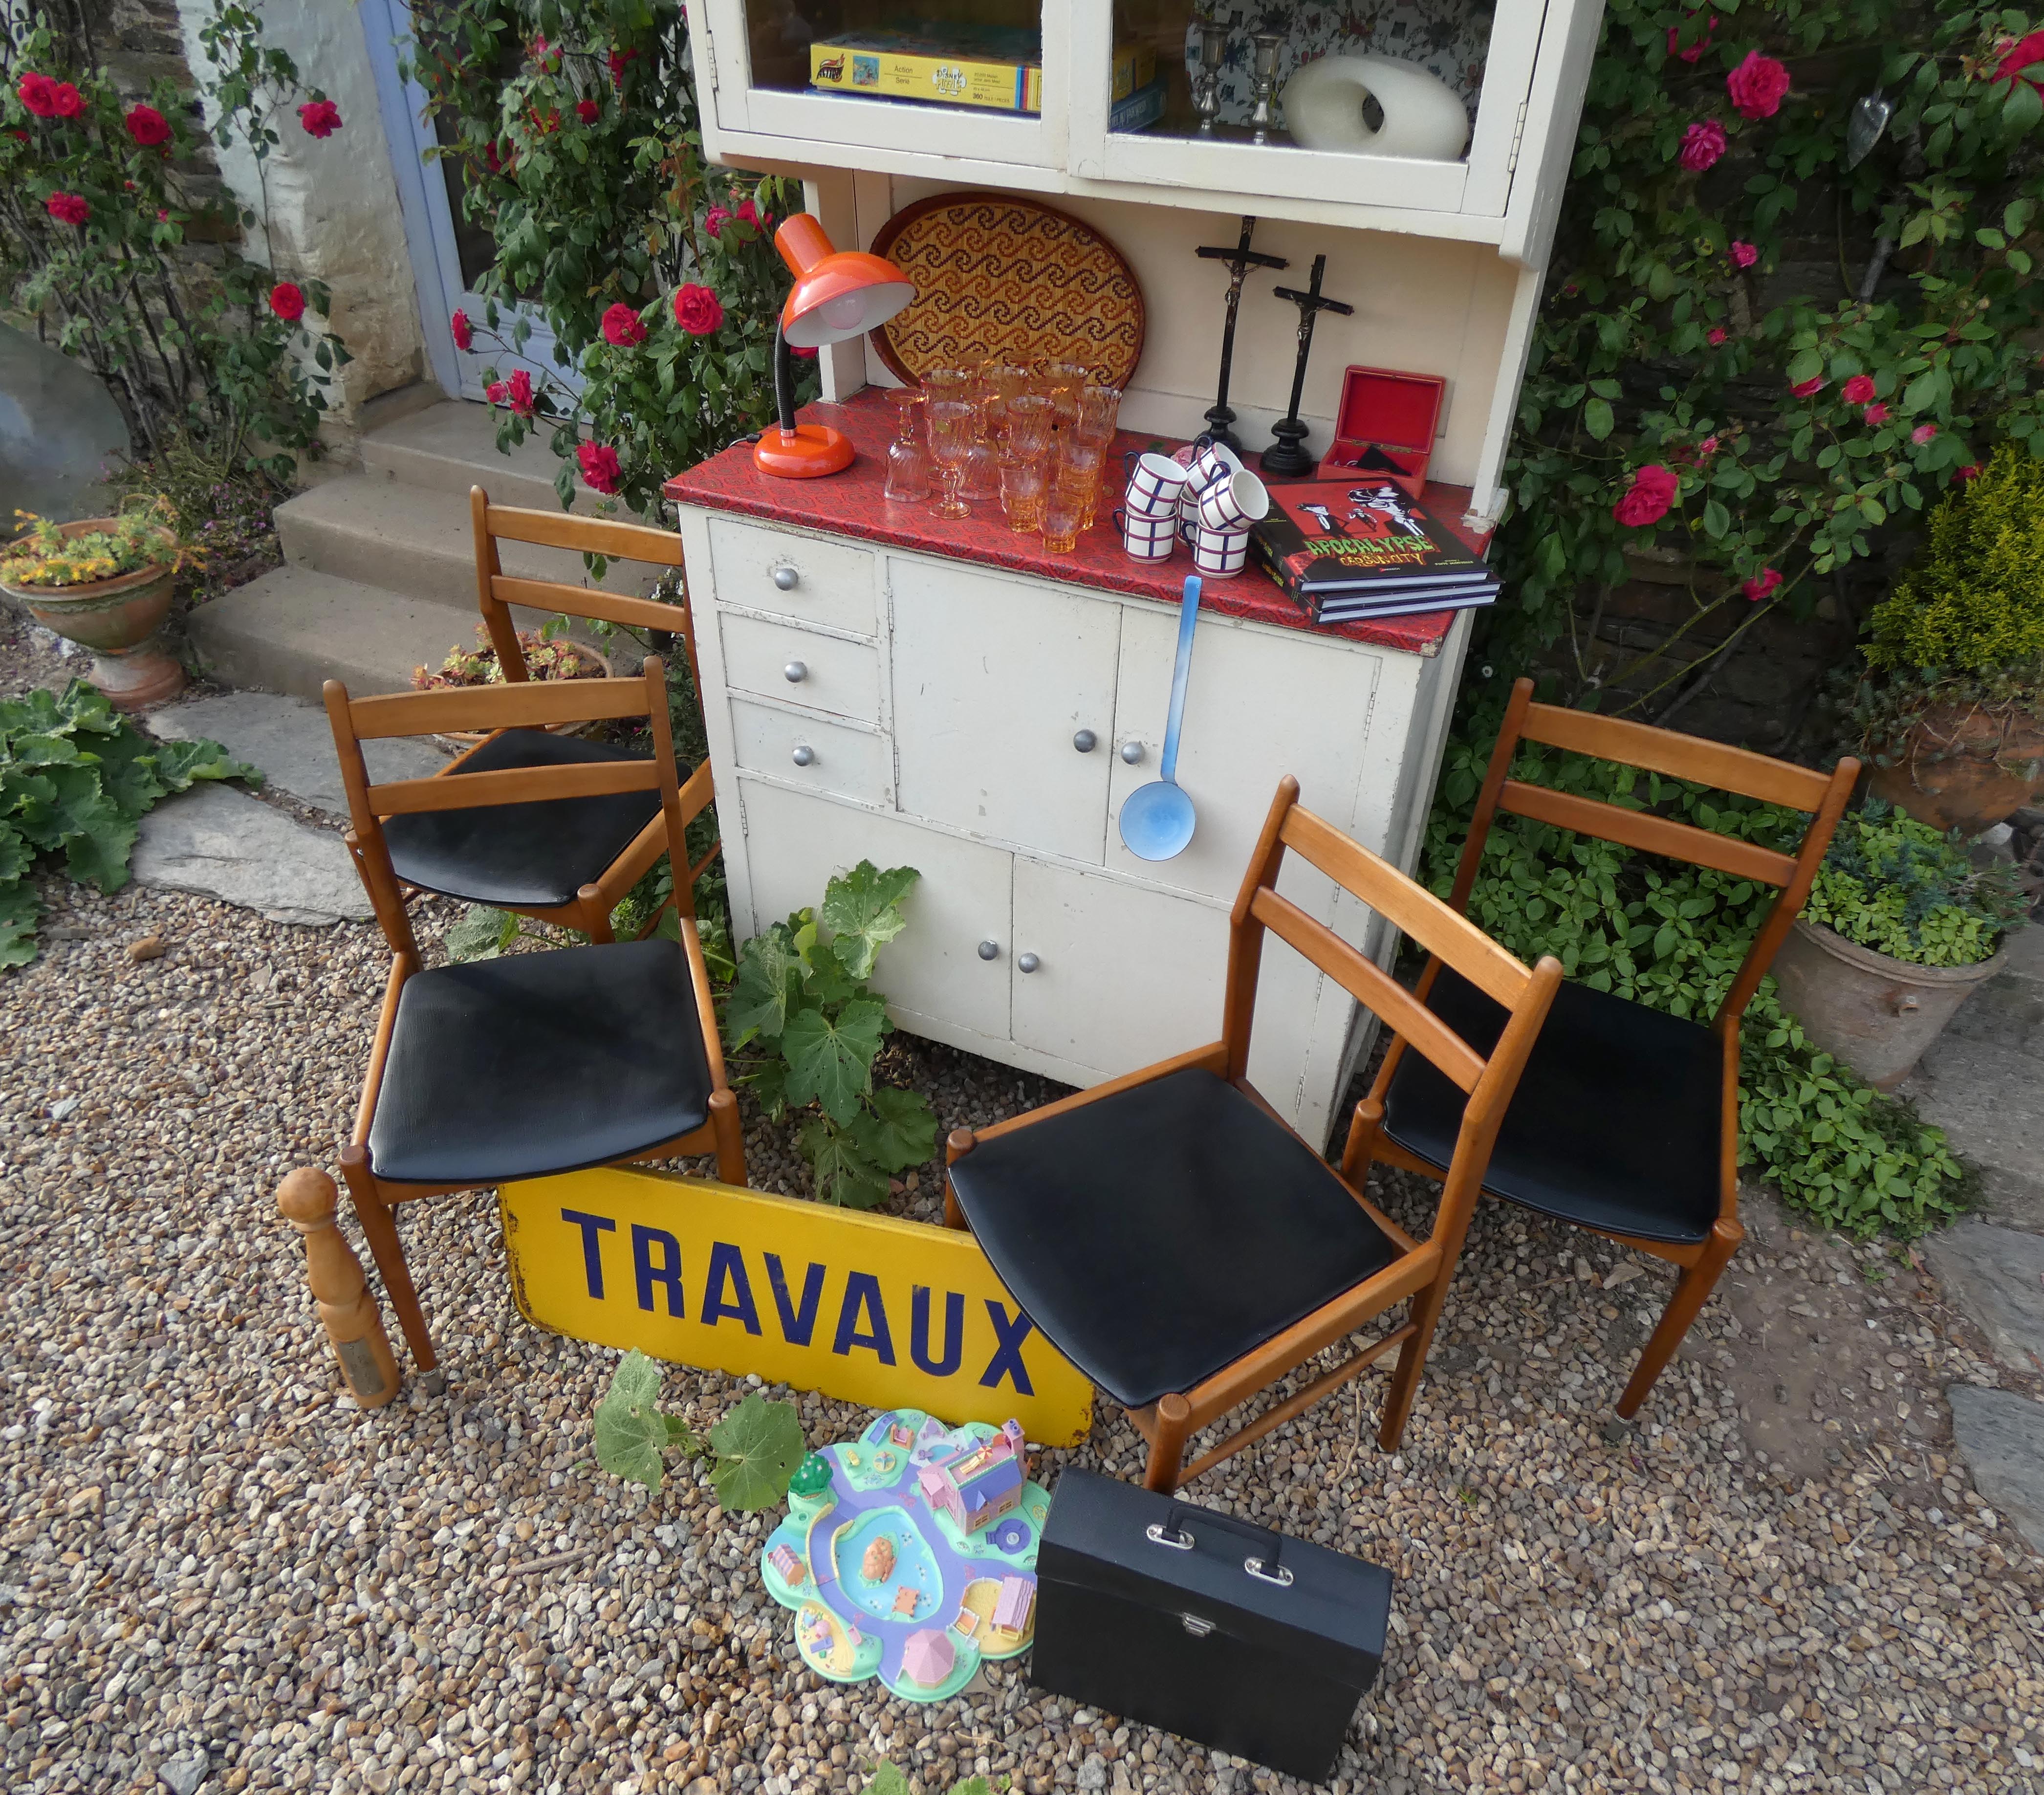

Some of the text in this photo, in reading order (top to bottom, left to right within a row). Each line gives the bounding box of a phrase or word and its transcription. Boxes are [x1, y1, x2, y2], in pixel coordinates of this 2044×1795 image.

[894, 65, 913, 74] Action
[935, 68, 963, 81] DISNEY
[1304, 535, 1435, 556] APOCALYPSE
[1340, 555, 1391, 566] CARSON
[1390, 553, 1424, 565] CITY
[561, 1207, 1035, 1397] TRAVAUX
